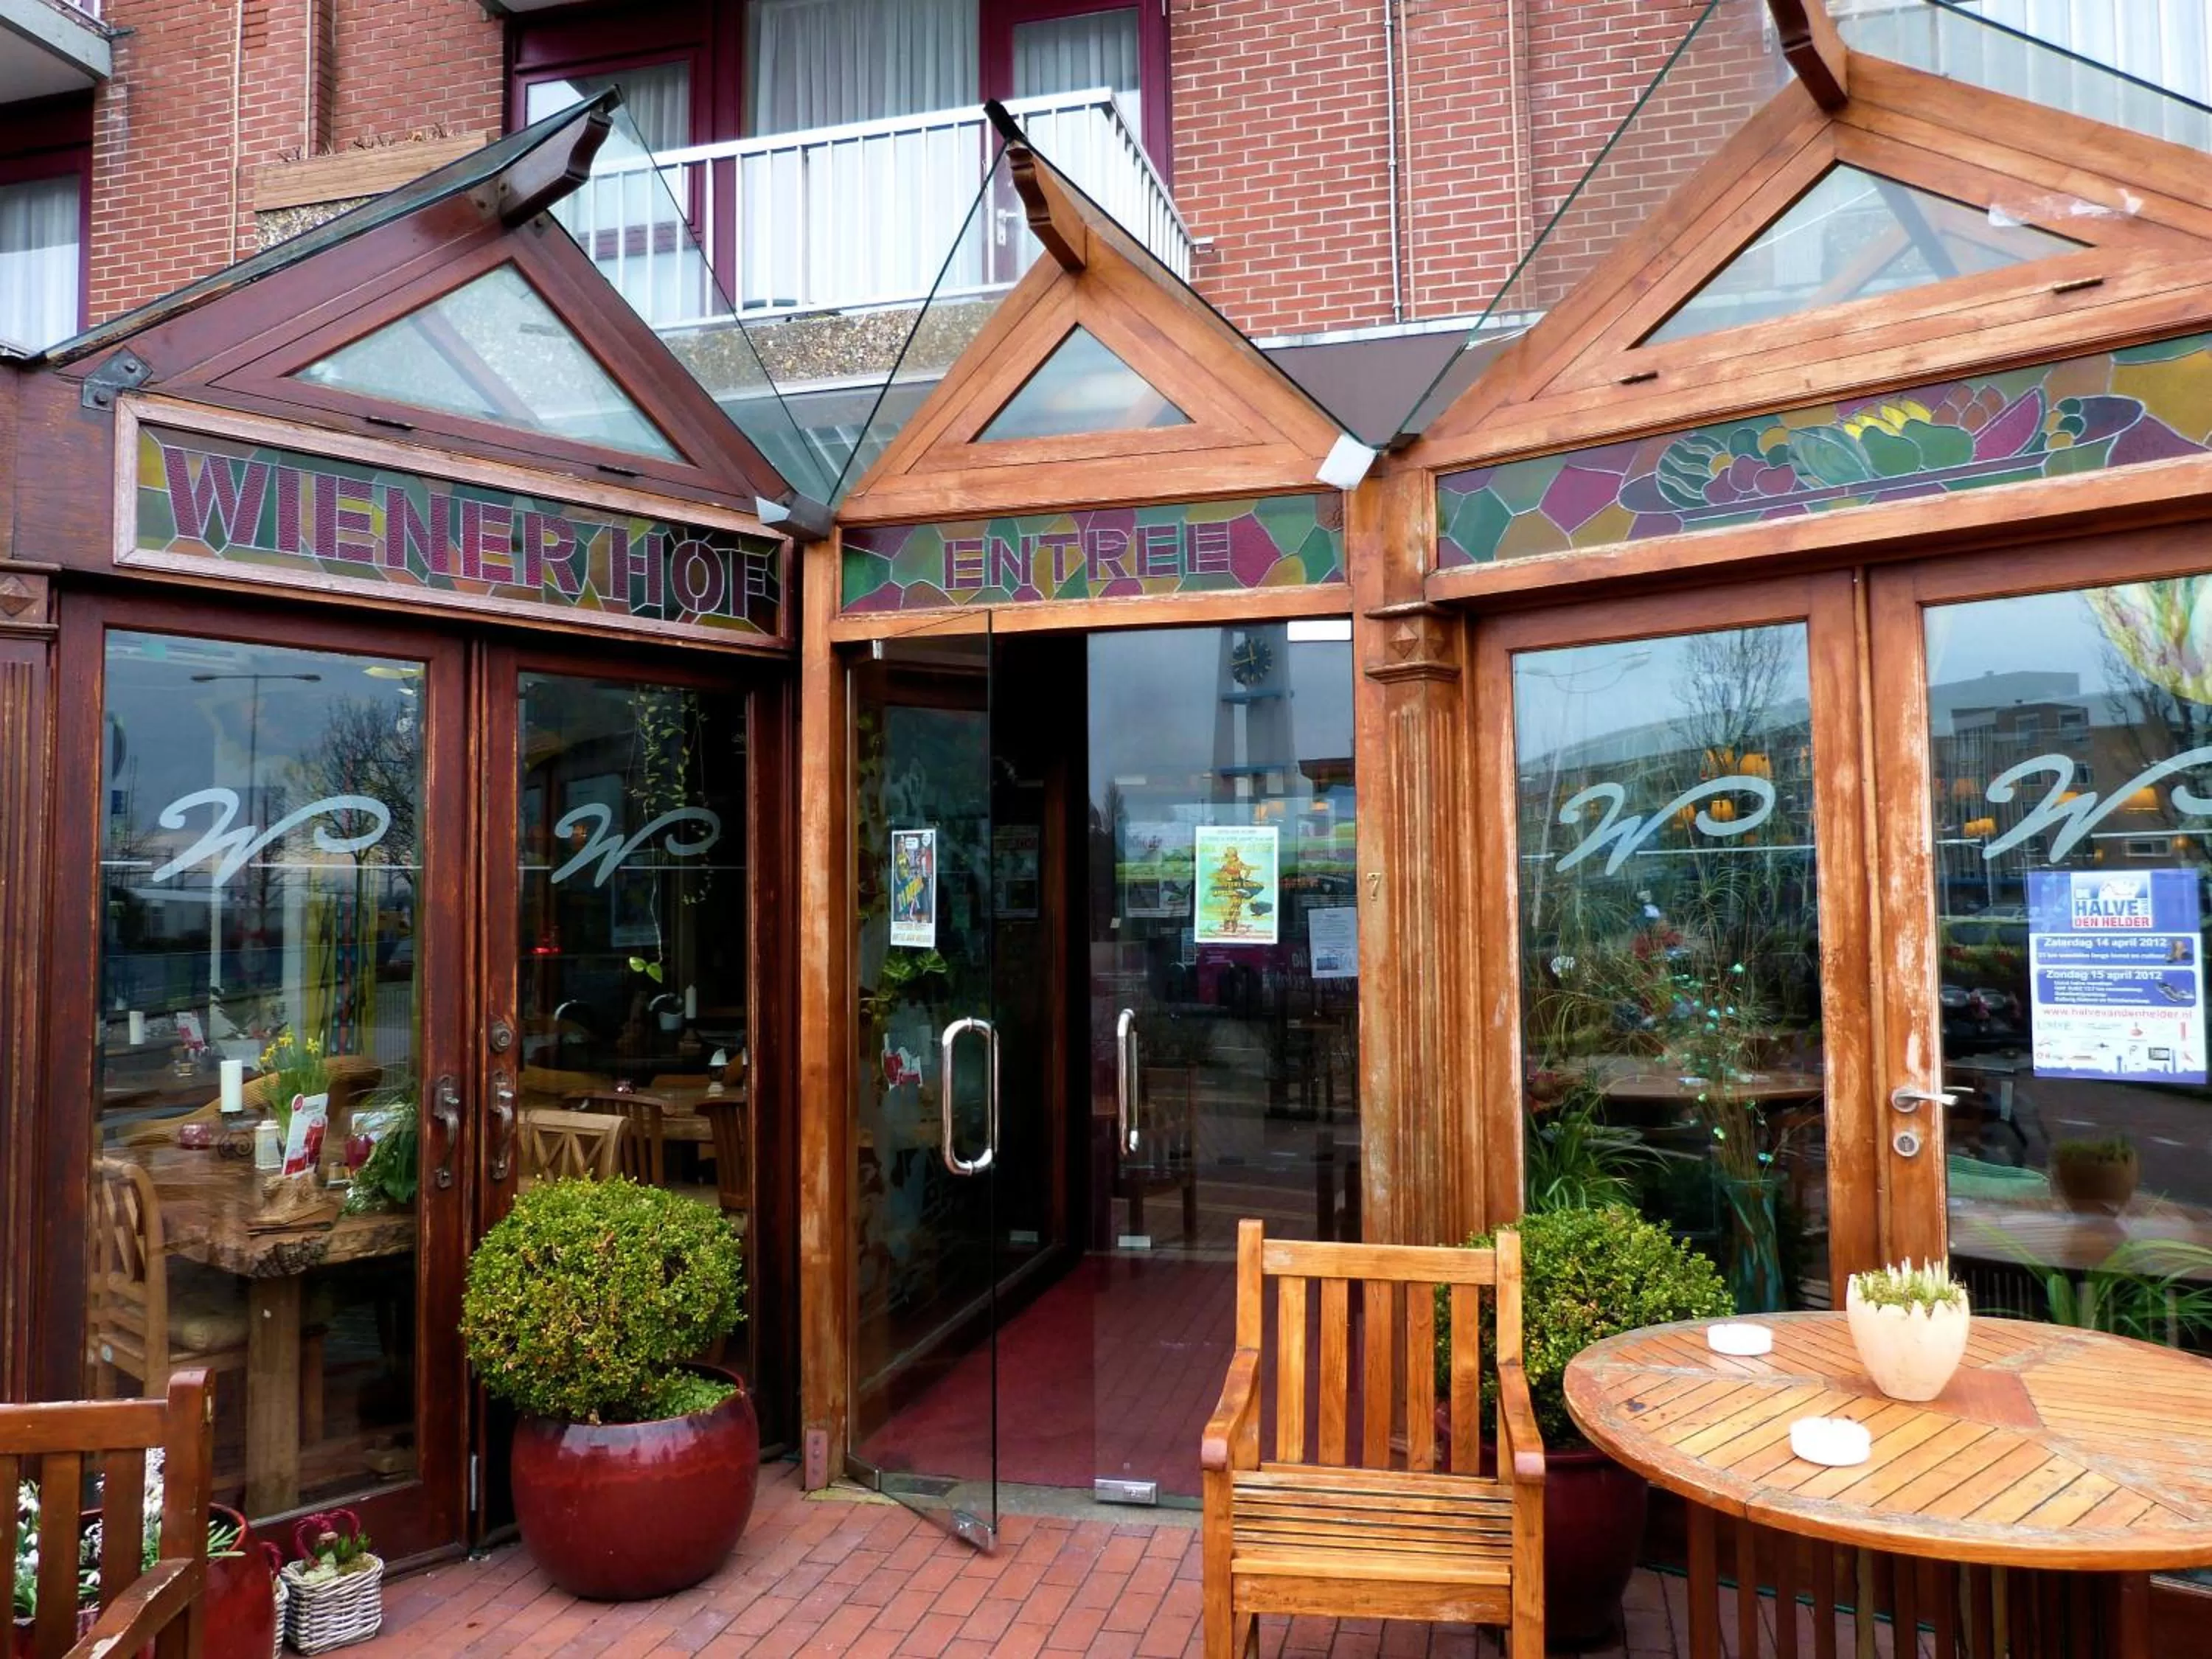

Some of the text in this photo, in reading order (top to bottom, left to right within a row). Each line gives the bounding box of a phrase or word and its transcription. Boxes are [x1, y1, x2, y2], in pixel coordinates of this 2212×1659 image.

[163, 445, 768, 619] WIENER HOF
[945, 522, 1230, 589] ENTREE
[2075, 900, 2139, 917] HALVE
[2074, 917, 2150, 928] DEN HELDER
[2096, 938, 2110, 947] 14
[2111, 937, 2137, 948] april
[2139, 937, 2168, 947] 2012
[2045, 970, 2163, 981] Zondag 15 april 2012
